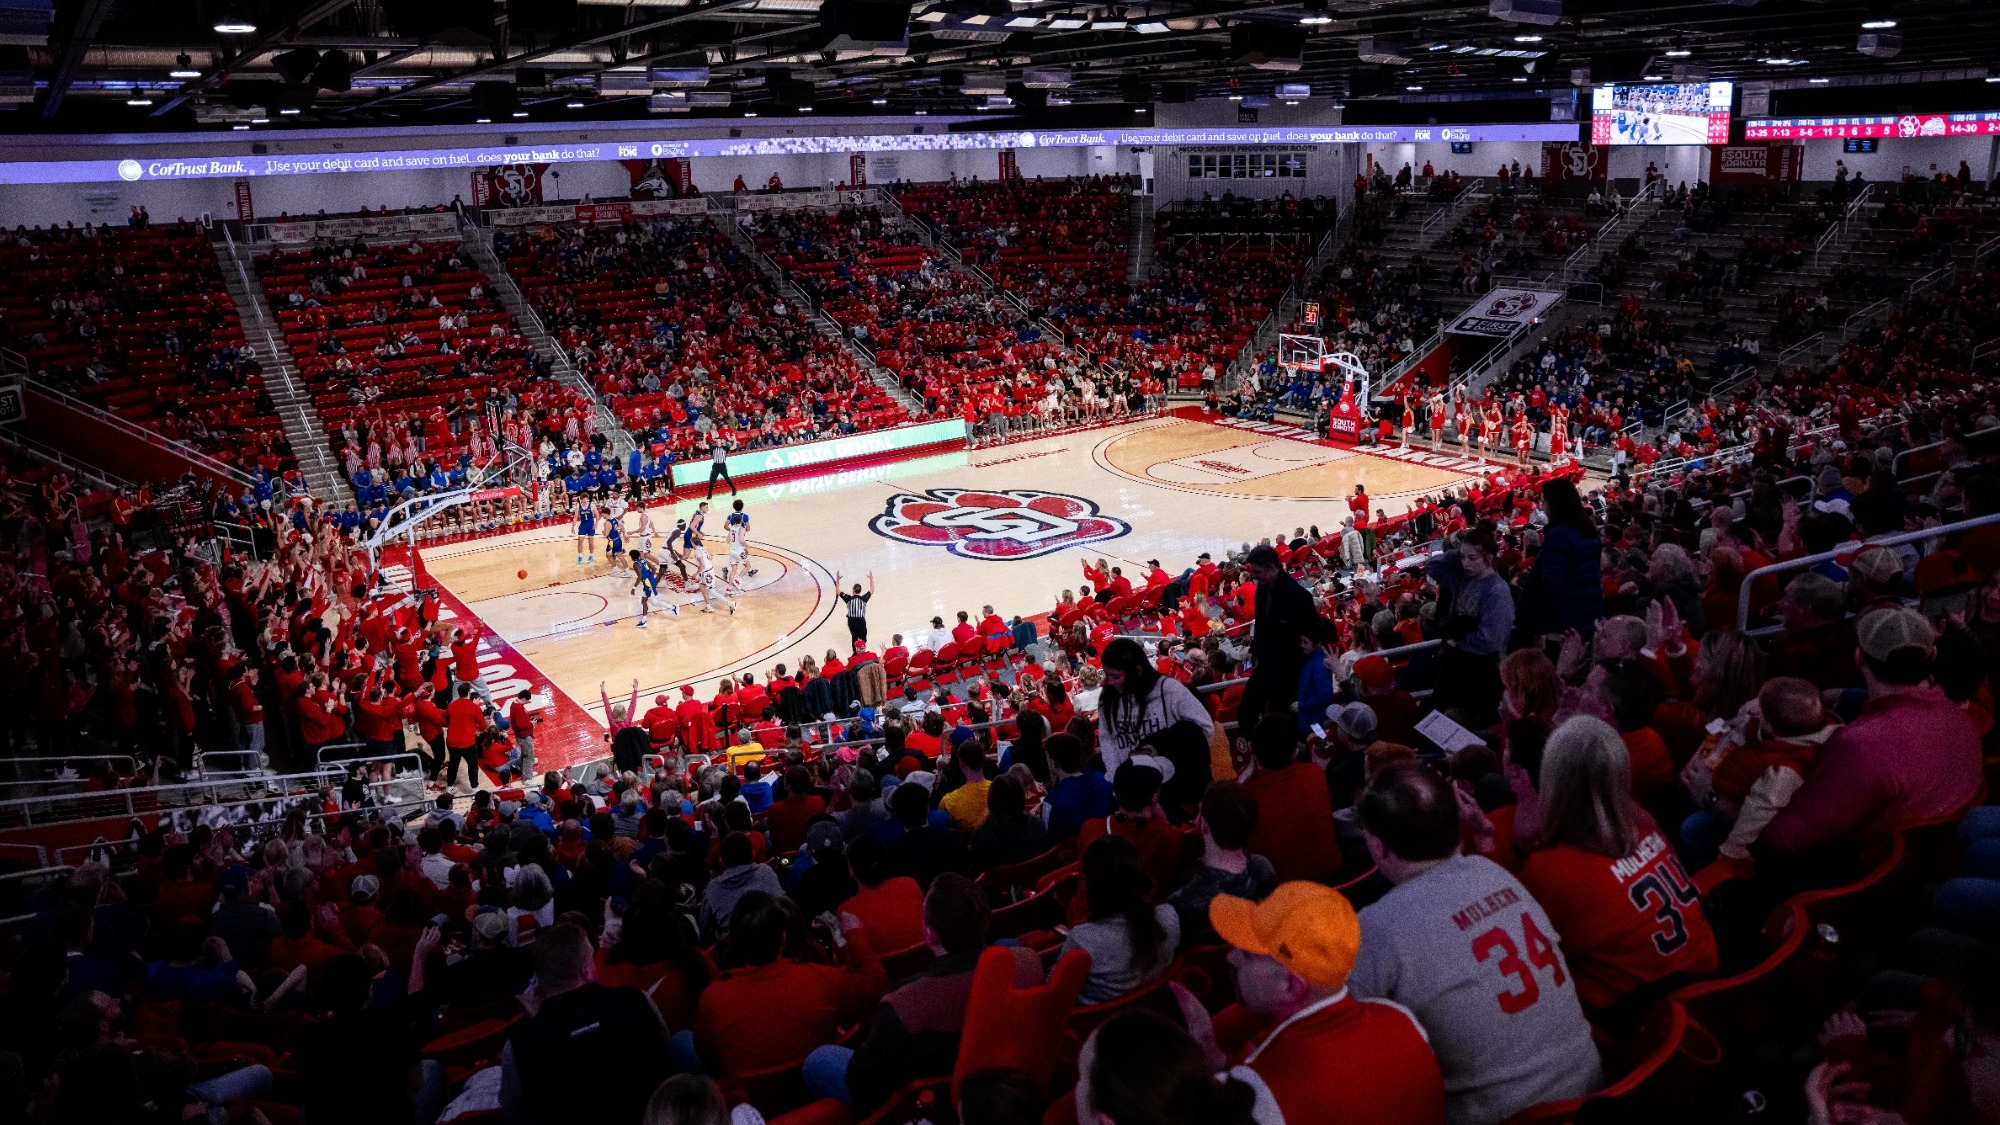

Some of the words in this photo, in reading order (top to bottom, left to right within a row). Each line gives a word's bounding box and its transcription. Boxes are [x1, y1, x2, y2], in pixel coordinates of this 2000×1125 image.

[1773, 129, 1790, 137] 7-13
[1823, 128, 1833, 136] 11
[1838, 127, 1845, 136] 2
[1851, 127, 1858, 135] 6
[1865, 127, 1872, 135] 3
[1883, 126, 1891, 134] 5
[1950, 123, 1978, 133] 14-30
[1039, 134, 1080, 145] CorTrust
[1121, 133, 1138, 143] Use
[1139, 134, 1160, 145] your
[1162, 132, 1185, 142] debit
[1186, 132, 1206, 142] card
[1207, 132, 1225, 141] and
[1226, 133, 1248, 141] save
[1249, 132, 1262, 141] on
[1310, 132, 1333, 142] your
[1335, 131, 1360, 140] bank
[1361, 131, 1374, 140] do
[1375, 130, 1398, 140] that?
[1726, 150, 1767, 159] SOUTH
[267, 160, 290, 172] Use
[292, 161, 320, 175] your
[323, 158, 352, 170] debit
[354, 156, 379, 168] card
[382, 156, 403, 167] and
[406, 156, 430, 166] save
[432, 156, 447, 165] on
[504, 151, 530, 164] your
[532, 150, 560, 160] bank
[561, 149, 575, 159] do
[576, 148, 600, 158] that?
[1725, 159, 1767, 167] DAKOTA
[149, 162, 207, 176] CorTrust
[209, 160, 247, 174] Bank.
[239, 185, 252, 221] VOLLEYBALL
[1305, 311, 1316, 323] 30
[1479, 321, 1517, 329] FIRST
[1332, 417, 1355, 427] SOUTH
[1332, 424, 1355, 433] DAKOTA
[788, 448, 834, 465] DELTA
[835, 437, 895, 453] DENTAL
[731, 532, 737, 543] 3
[1628, 851, 1701, 957] 34
[1471, 911, 1566, 1015] 34
